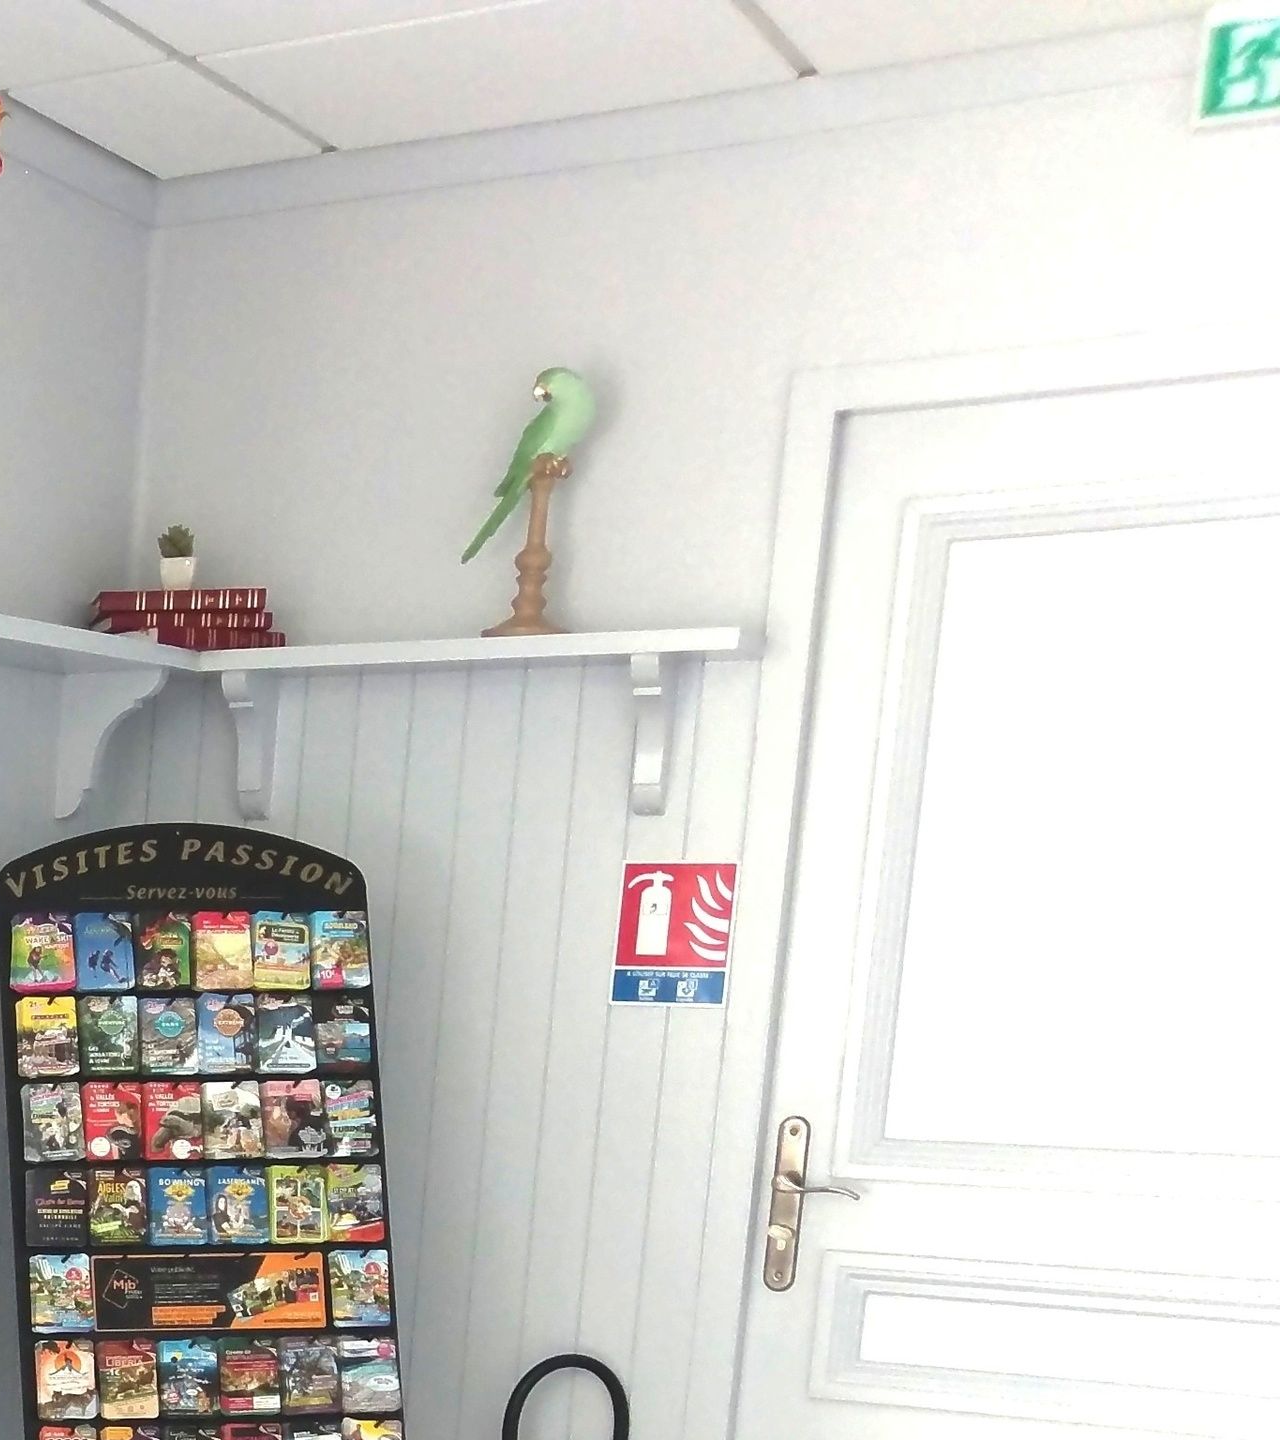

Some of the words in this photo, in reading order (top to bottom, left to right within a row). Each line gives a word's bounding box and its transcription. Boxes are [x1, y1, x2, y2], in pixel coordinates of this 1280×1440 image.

[5, 838, 158, 900] VISITES
[181, 838, 353, 896] PASSION
[126, 884, 237, 901] Servez-vous
